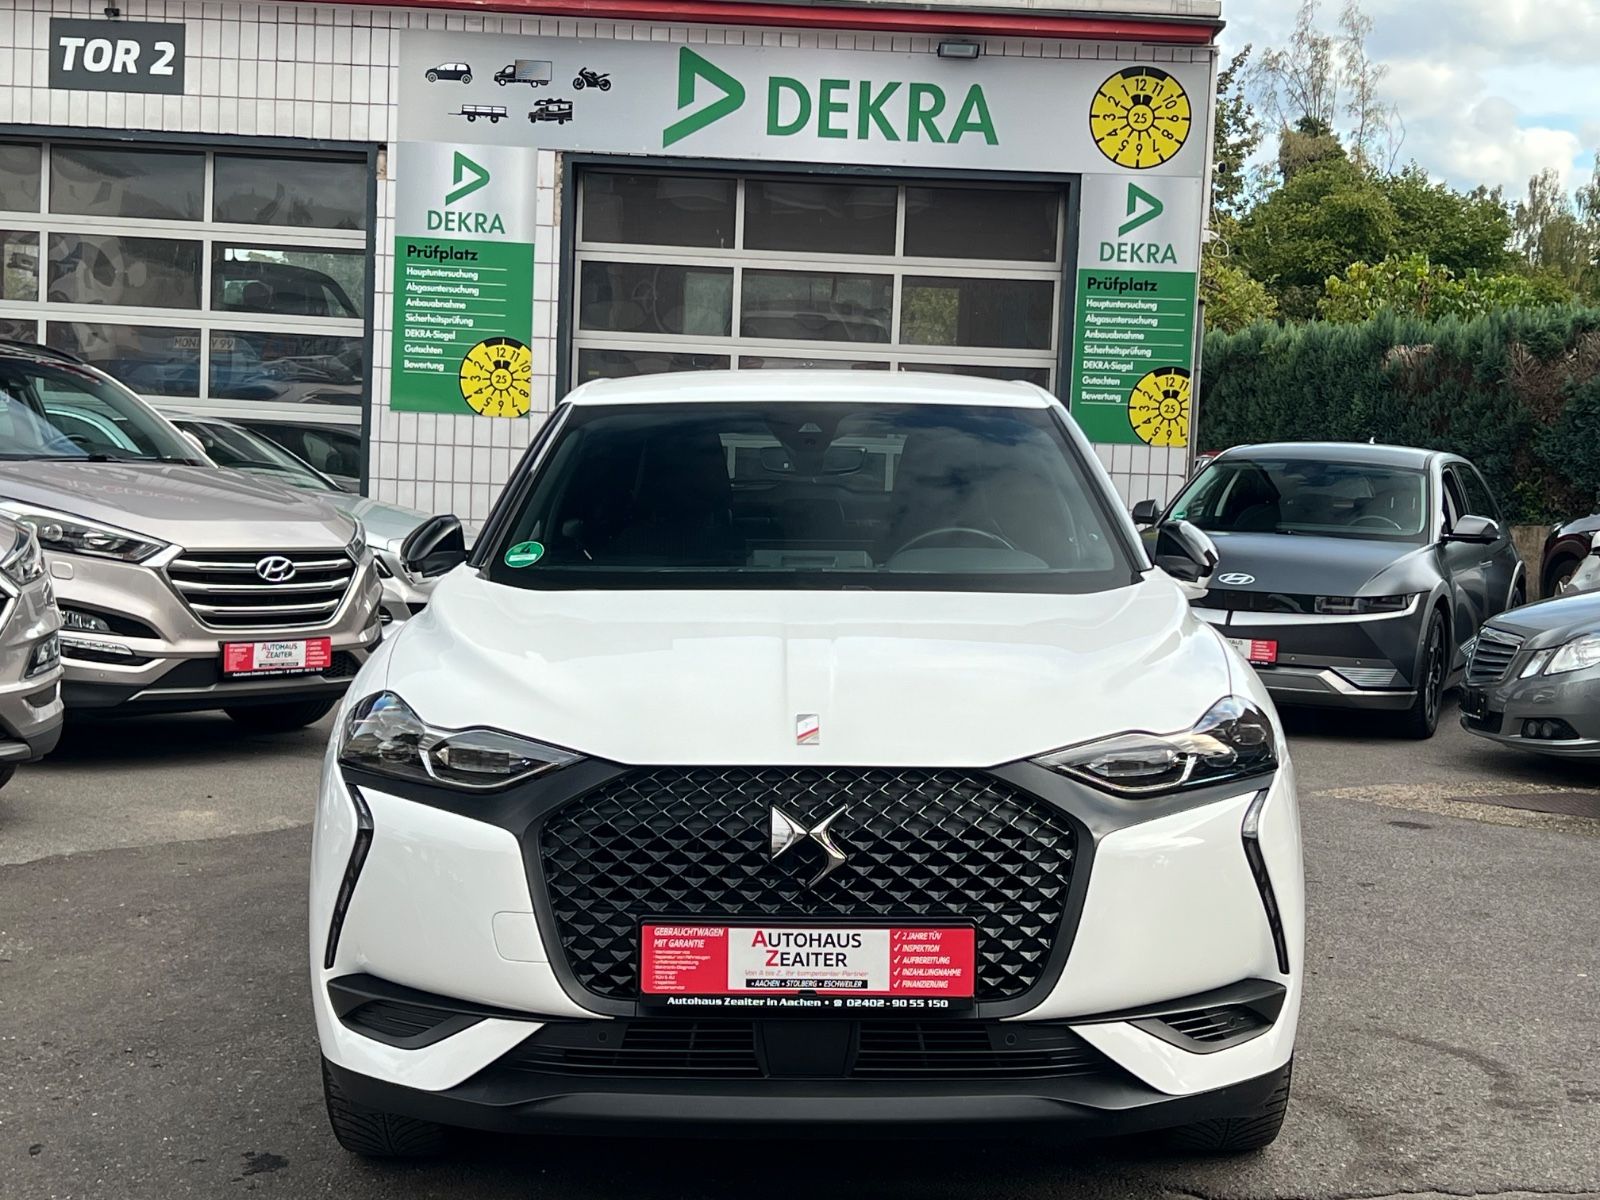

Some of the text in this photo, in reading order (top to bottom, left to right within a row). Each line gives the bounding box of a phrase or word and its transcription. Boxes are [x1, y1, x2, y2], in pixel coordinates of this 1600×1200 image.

[58, 37, 175, 76] TOR 2
[1121, 84, 1130, 96] 1
[1134, 78, 1147, 91] 12
[1152, 82, 1164, 96] 11
[1107, 95, 1120, 107] 2
[1162, 94, 1177, 109] 10
[766, 76, 999, 145] DEKRA
[1102, 113, 1116, 121] 3
[1133, 113, 1147, 123] 25
[1106, 128, 1118, 137] 4
[1161, 129, 1174, 140] 8
[1118, 139, 1129, 152] 5
[1136, 143, 1143, 156] 6
[1153, 139, 1160, 153] 7
[427, 210, 505, 234] DEKRA
[407, 245, 478, 263] Prüfplatz
[1100, 242, 1177, 264] DEKRA
[406, 267, 478, 280] Hauptuntersuchung
[406, 282, 479, 296] Abgasuntersuchung
[1088, 277, 1158, 294] Prüfplatz
[405, 298, 466, 309] Anbauabnahme
[1086, 299, 1158, 311] Hauptuntersuchung
[405, 313, 474, 327] Sicherheitsprüfung
[1085, 314, 1158, 327] Abgasuntersuchung
[405, 329, 456, 341] DEKRA-Siegel
[1085, 330, 1144, 340] Anbauabnahme
[404, 344, 443, 354] Gutachten
[496, 347, 506, 357] 12
[1084, 345, 1152, 357] Sicherheitsprüfung
[485, 352, 492, 361] 1
[510, 350, 520, 362] 11
[404, 360, 444, 371] Bewertung
[474, 361, 484, 370] 2
[519, 360, 531, 373] 10
[1083, 360, 1133, 372] DEKRA-Siegel
[496, 375, 507, 384] 25
[1082, 376, 1120, 385] Gutachten
[1165, 377, 1175, 387] 12
[1154, 382, 1161, 391] 1
[1179, 380, 1189, 391] 11
[519, 389, 529, 398] 8
[1082, 391, 1121, 402] Bewertung
[1143, 391, 1153, 400] 2
[484, 397, 492, 407] 5
[498, 400, 504, 410] 6
[512, 397, 518, 408] 7
[1164, 405, 1176, 413] 25
[1152, 427, 1161, 436] 5
[1167, 430, 1172, 440] 6
[1180, 426, 1186, 437] 7
[262, 643, 297, 651] AUTOHAUS
[266, 651, 292, 659] ZEAITER
[654, 927, 724, 937] GEBRAUCHTWAGEN
[907, 932, 928, 940] JAHRE
[928, 931, 942, 940] TÜV
[654, 939, 705, 948] MIT GARANTIE
[752, 930, 862, 948] AUTOHAUS
[902, 944, 940, 952] INSPEKTION
[765, 950, 847, 967] ZEAITER
[902, 956, 950, 964] AUFBEREITUNG
[902, 968, 962, 976] INZAHLUNGNAHME
[902, 980, 948, 988] FINANZIERUNG
[667, 996, 722, 1005] Autohaus
[724, 997, 765, 1006] Zeaiter
[767, 997, 777, 1006] in
[779, 998, 821, 1007] Aachen
[847, 999, 884, 1007] 02402
[892, 999, 907, 1007] 90
[909, 999, 925, 1008] 55
[927, 999, 949, 1008] 150
